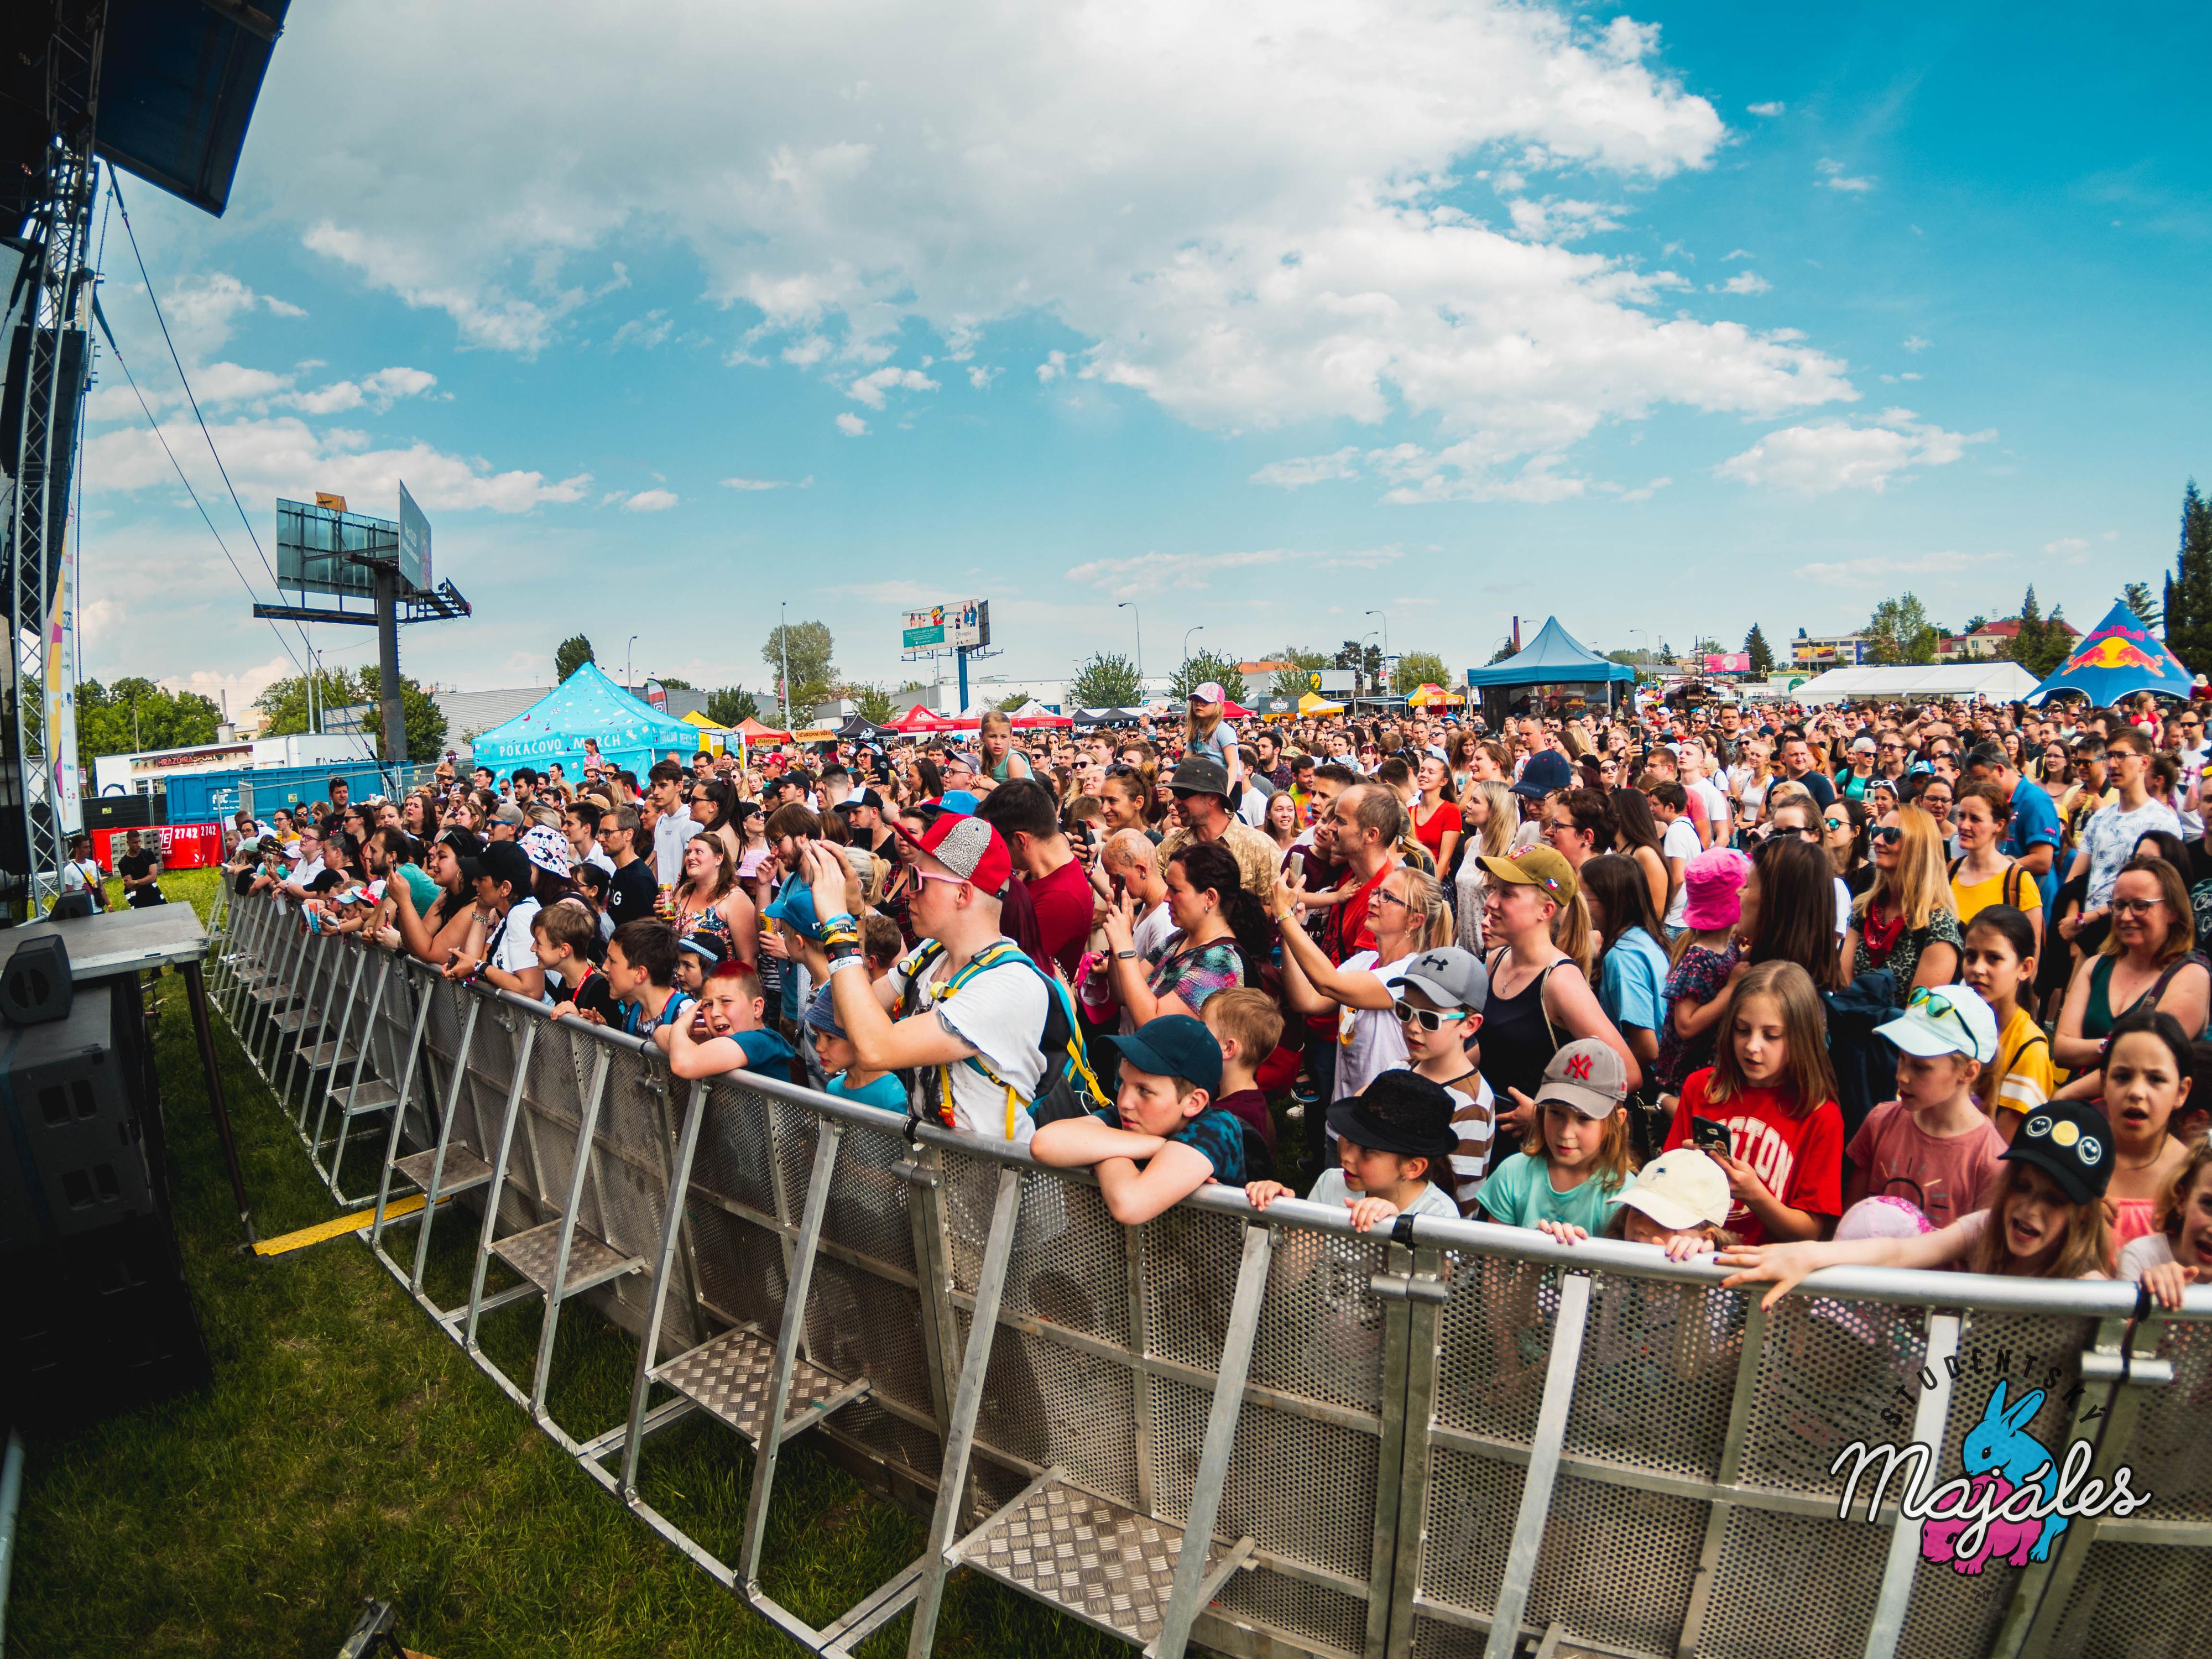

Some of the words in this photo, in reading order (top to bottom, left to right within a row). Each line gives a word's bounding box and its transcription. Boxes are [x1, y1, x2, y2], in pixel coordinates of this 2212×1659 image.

[2088, 625, 2115, 641] Red
[2116, 625, 2145, 641] Bull
[499, 738, 561, 757] POKÁČOVO
[573, 734, 620, 749] MRCH
[175, 827, 198, 839] 2742
[201, 825, 216, 836] 2742
[1564, 1053, 1593, 1080] NY
[1715, 1116, 1794, 1202] STON
